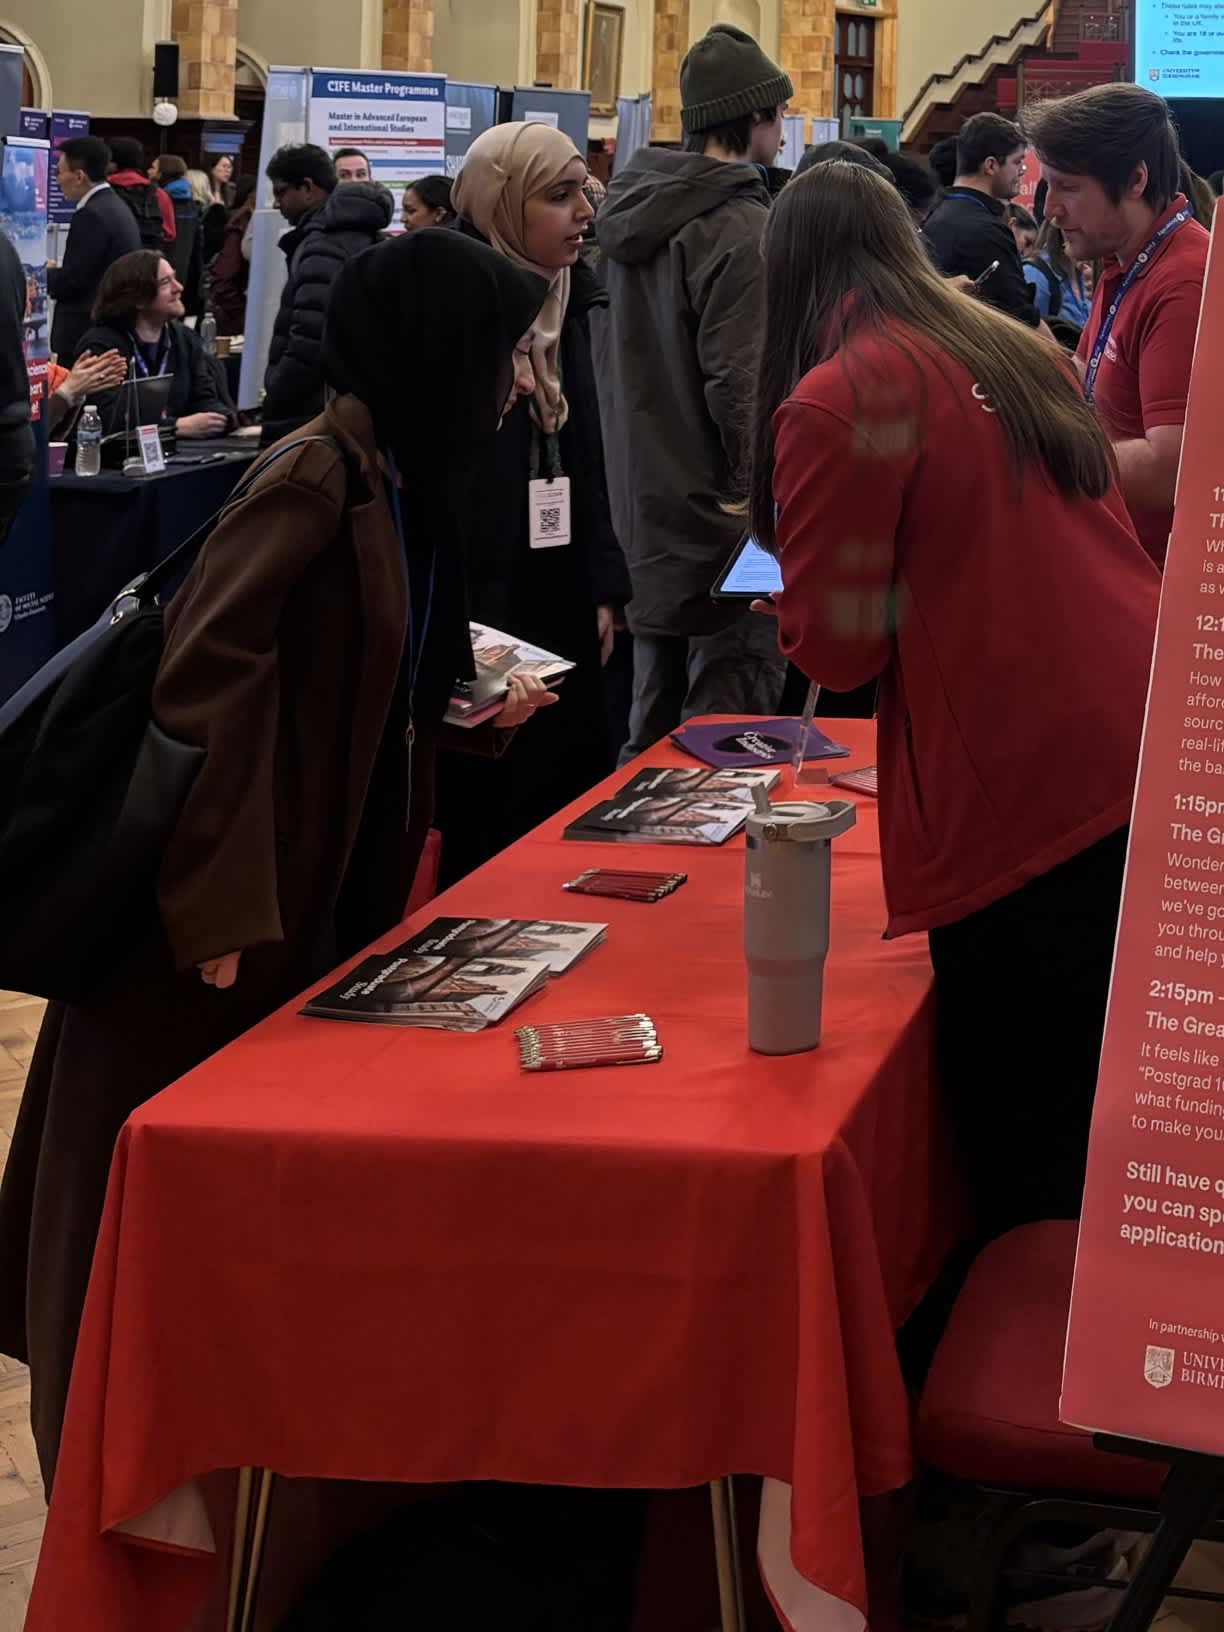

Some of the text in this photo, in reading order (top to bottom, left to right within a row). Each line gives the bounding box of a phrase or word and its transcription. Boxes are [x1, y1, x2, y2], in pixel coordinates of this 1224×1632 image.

[327, 79, 439, 98] CIFE Master Programmes
[328, 111, 353, 121] Master
[362, 112, 395, 122] Advanced
[343, 122, 389, 132] International
[390, 123, 414, 134] Studies
[1157, 921, 1186, 938] you
[1148, 979, 1215, 1007] 2:15pm
[1131, 1113, 1148, 1130] to
[1149, 1118, 1193, 1137] make
[1148, 1317, 1160, 1331] In
[1159, 1322, 1221, 1345] partnership
